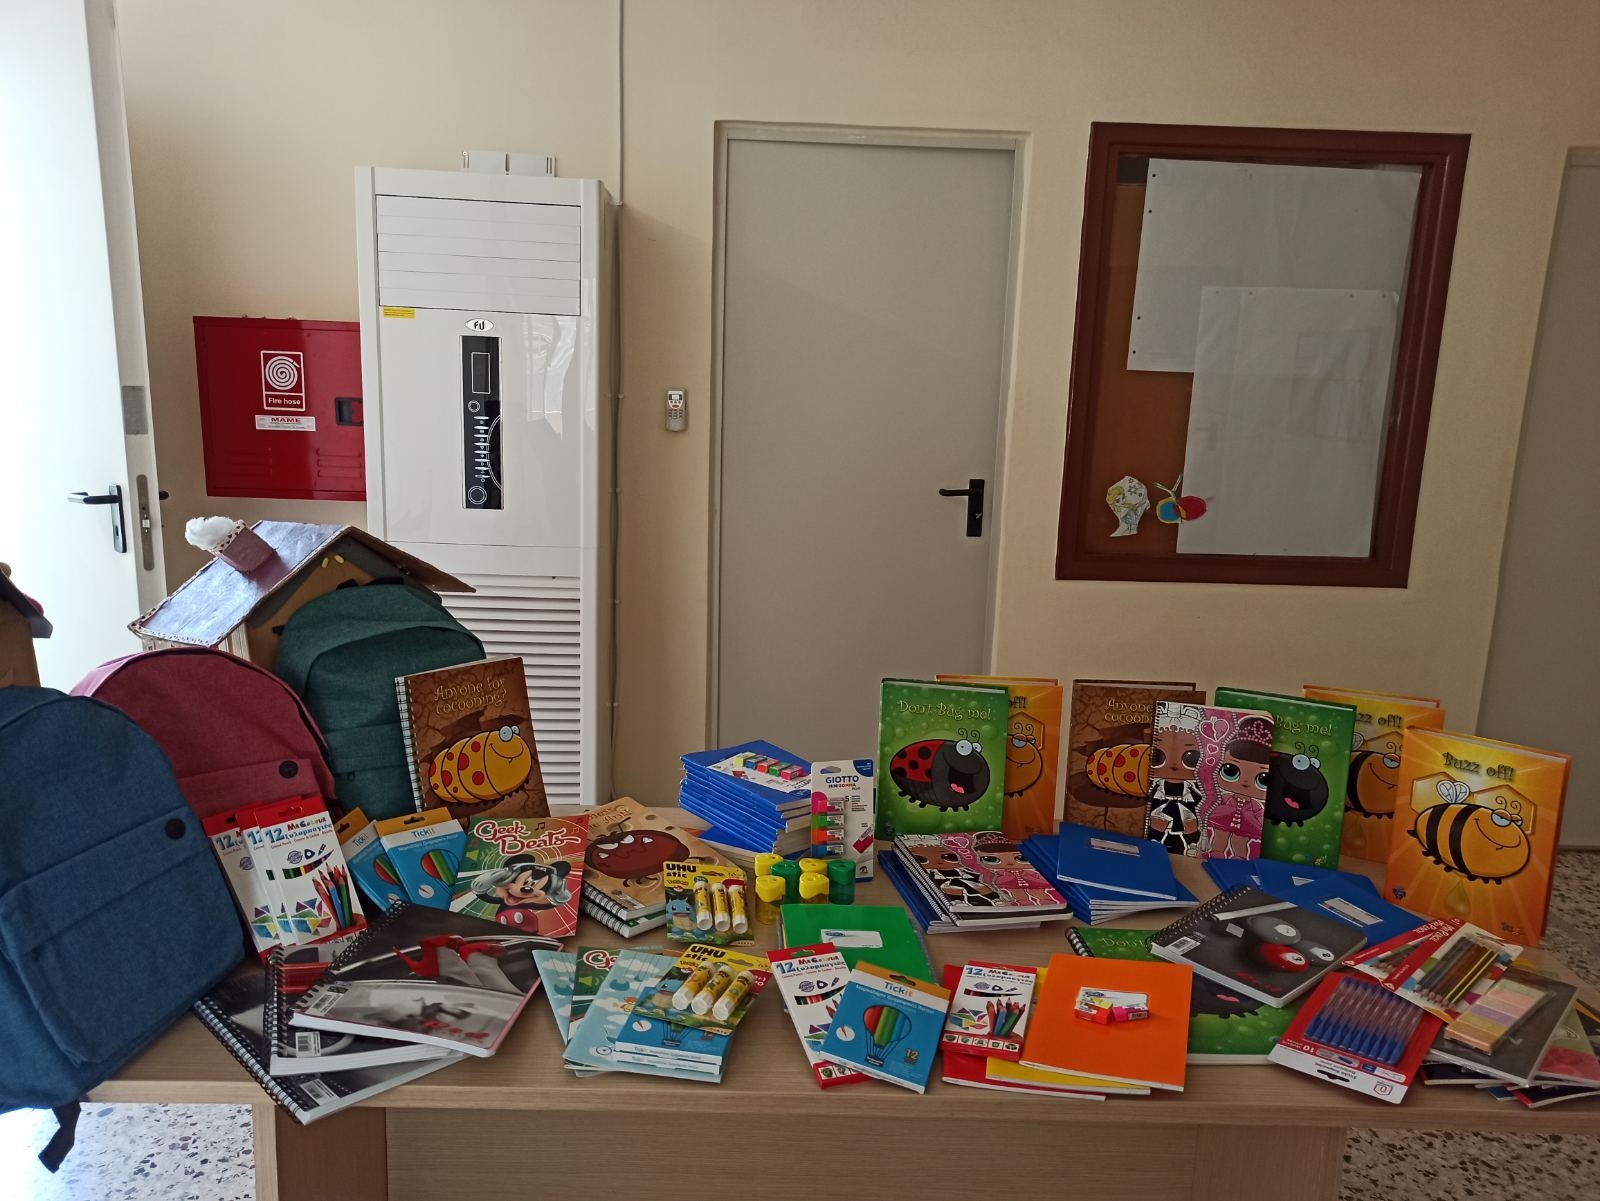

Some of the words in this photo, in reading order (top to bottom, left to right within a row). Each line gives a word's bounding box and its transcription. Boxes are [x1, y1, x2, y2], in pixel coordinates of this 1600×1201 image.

[434, 682, 483, 702] Anyone
[487, 676, 504, 690] for
[436, 687, 508, 715] cocooning?
[897, 699, 933, 713] Don't
[937, 701, 963, 721] Bag
[967, 703, 992, 721] me!
[1306, 718, 1333, 737] me!
[1377, 713, 1404, 729] off!
[1442, 751, 1481, 775] Buzz
[1486, 763, 1516, 782] off!
[825, 775, 860, 784] GIOTTO
[265, 827, 285, 844] 12
[474, 820, 531, 844] Geek
[216, 834, 234, 850] 12
[494, 828, 582, 855] Beats
[665, 863, 697, 873] UHU
[684, 953, 709, 962] stic
[690, 945, 727, 959] UHU
[776, 962, 796, 974] 12
[966, 967, 983, 976] 12
[906, 1048, 919, 1060] 12
[1302, 1045, 1315, 1053] 10
